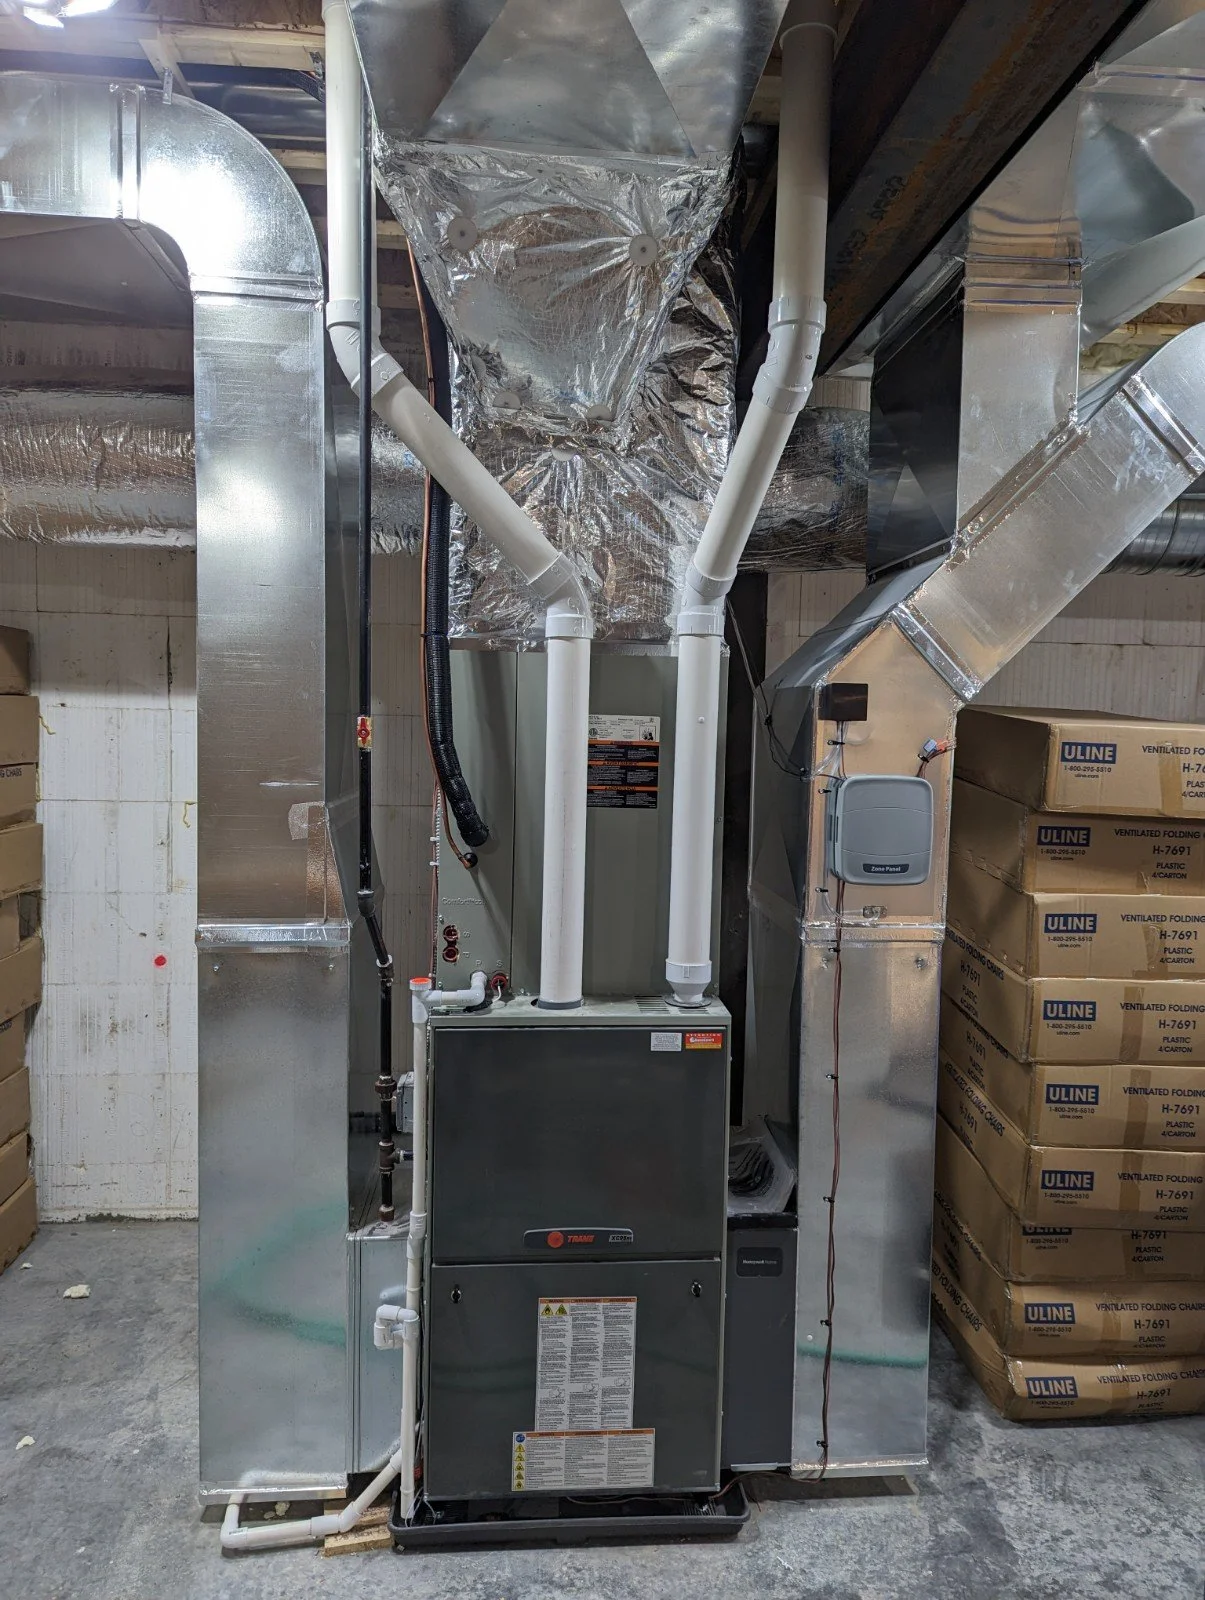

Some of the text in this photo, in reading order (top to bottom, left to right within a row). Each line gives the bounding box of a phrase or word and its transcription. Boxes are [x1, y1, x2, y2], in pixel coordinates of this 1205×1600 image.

[1064, 744, 1114, 761] ULINE
[1142, 745, 1190, 756] VENTILATED
[1064, 765, 1112, 774] 1-800-295-5510
[1041, 830, 1088, 844] ULINE
[1115, 829, 1200, 839] VENTILATED FOLDING
[1041, 848, 1086, 856] 1-800-295-5510
[1153, 846, 1191, 856] H-7691
[1156, 862, 1186, 870] PLASTIC
[1152, 872, 1187, 880] 4/CARTON
[1048, 916, 1094, 931] ULINE
[1121, 914, 1205, 924] VENTILATED FOLDING
[1160, 930, 1198, 940] H-7691
[960, 960, 980, 986] H-7691
[1046, 1004, 1094, 1018] ULINE
[1120, 1002, 1205, 1013] VENTILATED FOLDING
[1159, 1020, 1197, 1030] H-7691
[1163, 1036, 1191, 1044] PLASTIC
[1050, 1087, 1096, 1102] ULINE
[1123, 1087, 1169, 1096] VENTILATED
[965, 1087, 986, 1114] FOLDING
[984, 1111, 1005, 1136] CHAIRS
[1162, 1104, 1200, 1115] H-7691
[1166, 1121, 1194, 1129] PLASTIC
[1045, 1173, 1091, 1188] ULINE
[1118, 1173, 1203, 1184] VENTILATED FOLDING
[1156, 1190, 1194, 1200] H-7691
[1160, 1206, 1188, 1214] PLASTIC
[568, 1235, 595, 1243] TRANE
[1132, 1230, 1167, 1240] H-7691
[940, 1272, 962, 1306] FOLDING
[960, 1302, 983, 1332] CHAIRS
[1096, 1303, 1139, 1311] VENTILATED
[1142, 1303, 1177, 1311] FOLDING
[1028, 1306, 1073, 1321] ULINE
[1134, 1320, 1170, 1329] H-7691
[1097, 1376, 1140, 1384] VENTILATED
[1143, 1373, 1178, 1382] FOLDING
[1029, 1380, 1076, 1396] ULINE
[1137, 1388, 1171, 1400] H-7691
